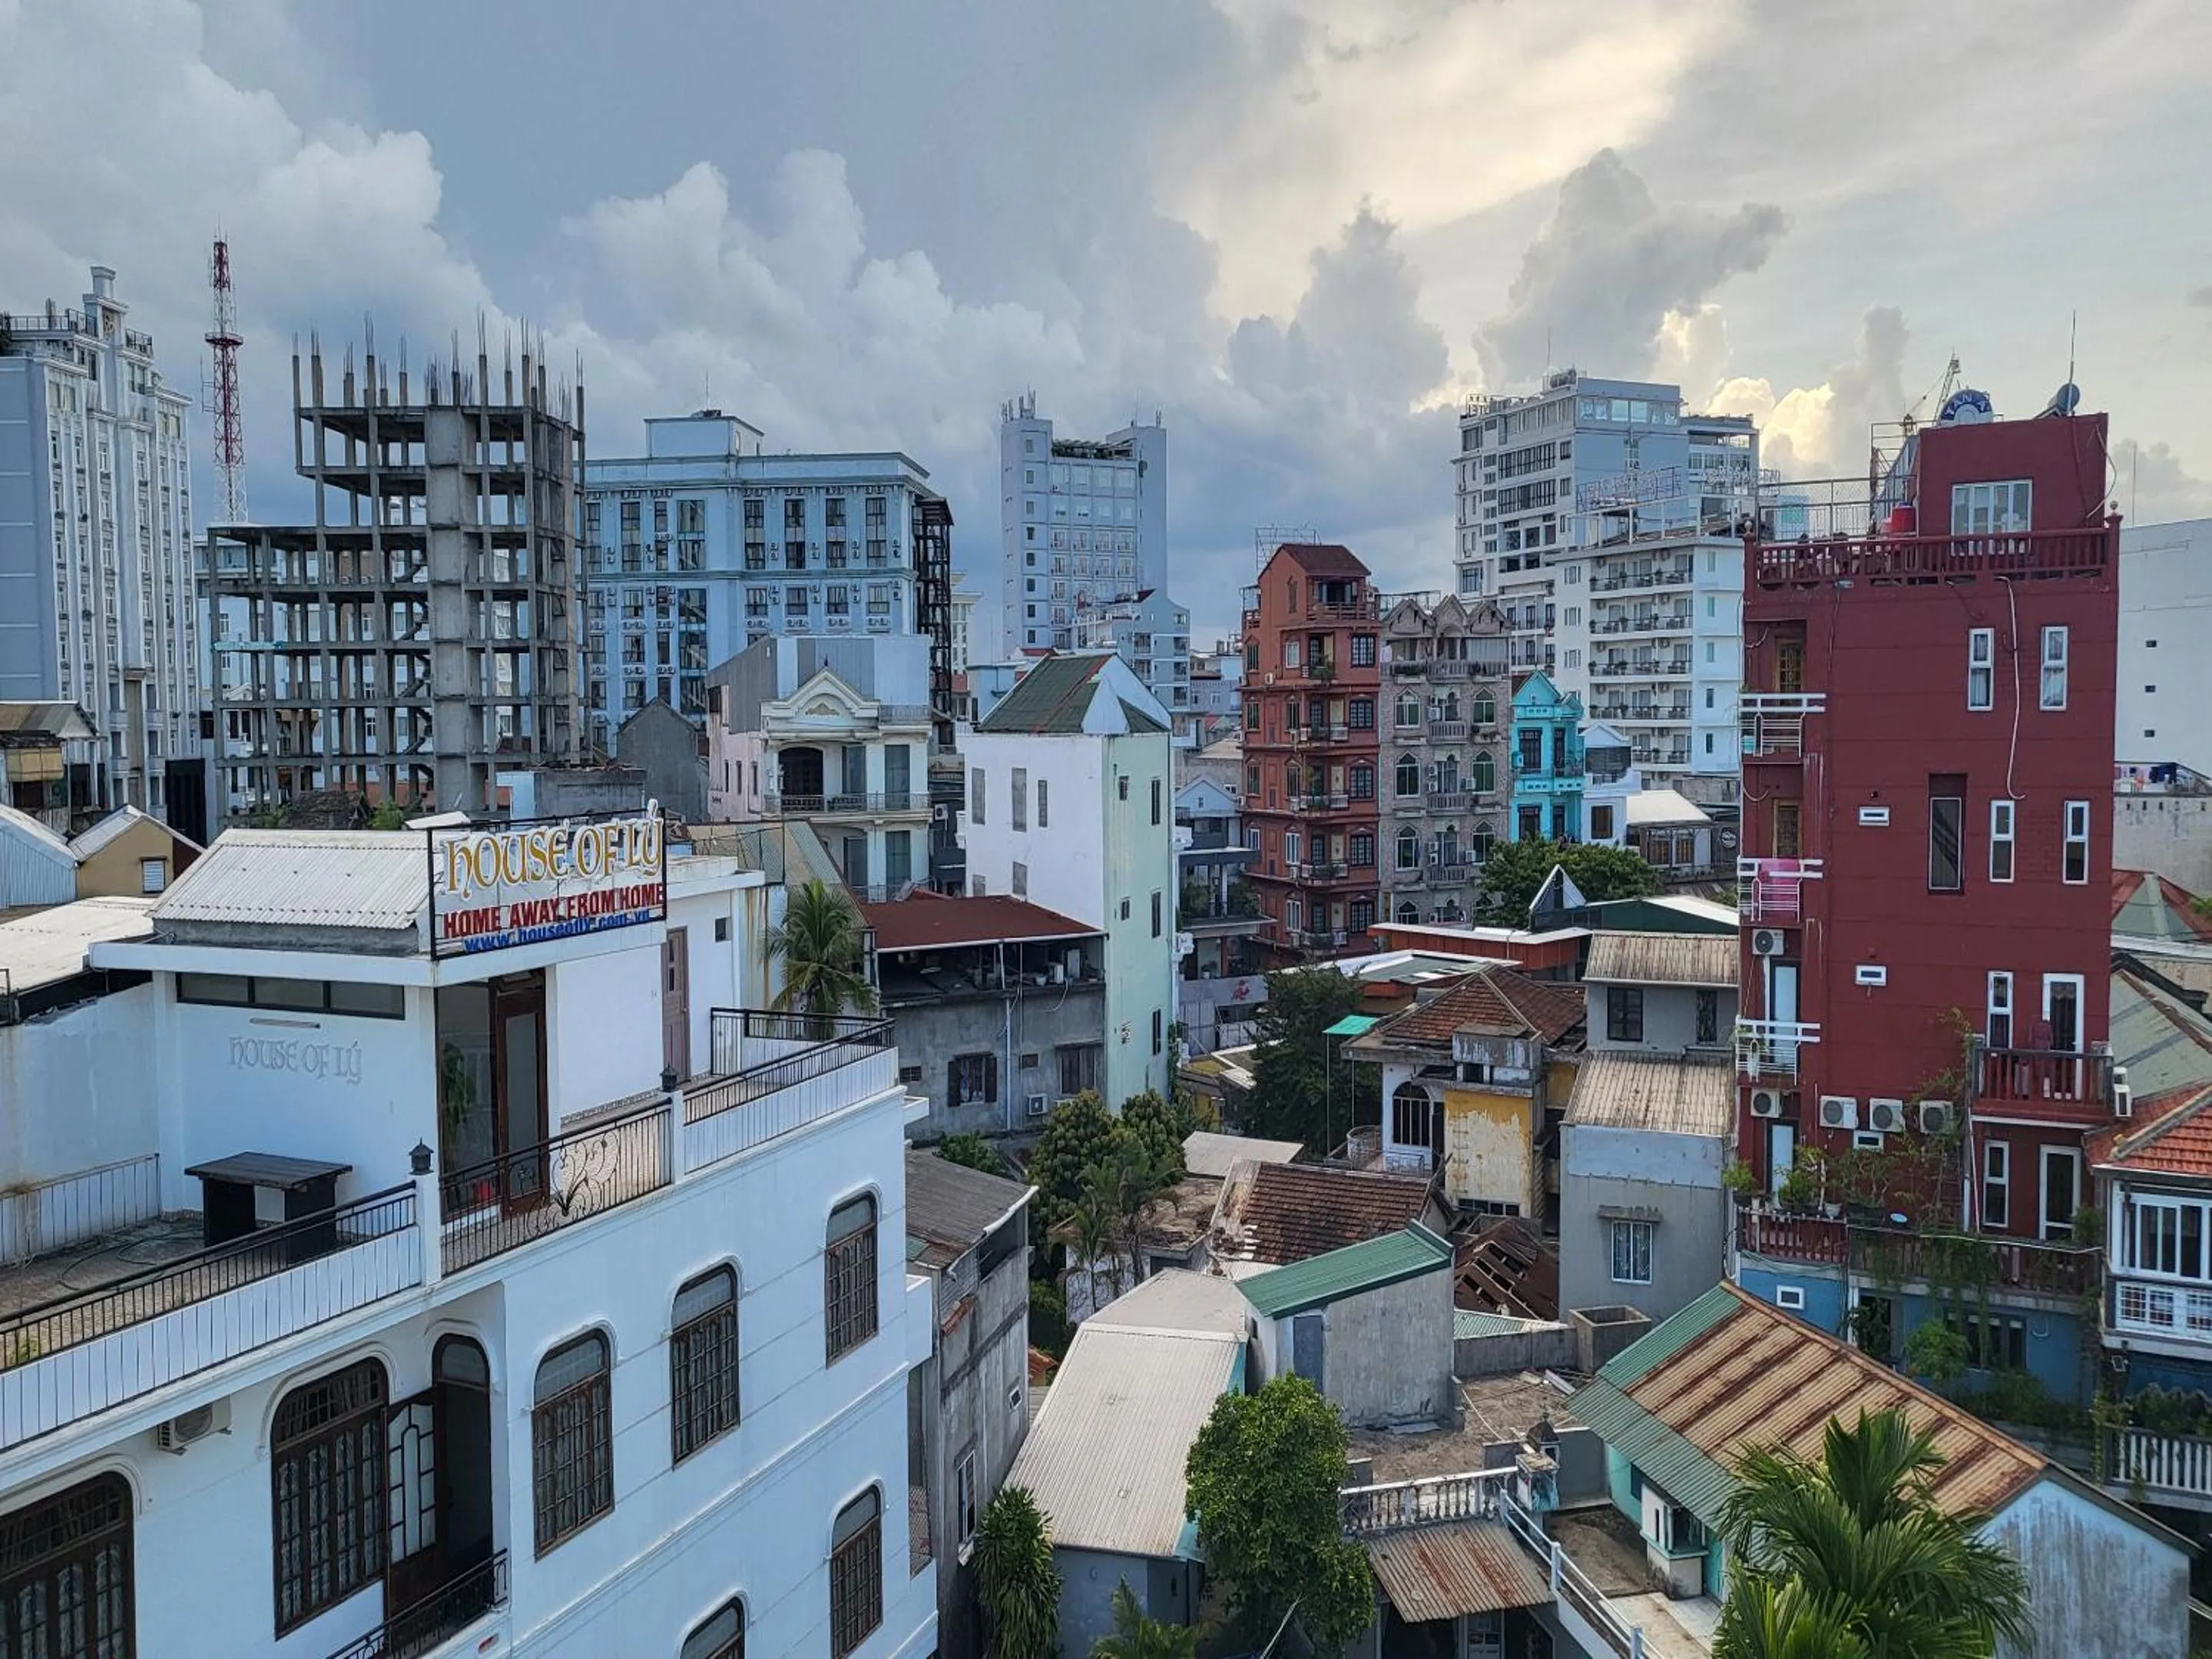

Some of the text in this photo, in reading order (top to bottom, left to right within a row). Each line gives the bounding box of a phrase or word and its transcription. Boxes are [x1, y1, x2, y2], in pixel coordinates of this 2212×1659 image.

[574, 819, 621, 879] OF
[443, 882, 665, 939] HOME AWAY FROM HOME
[304, 1043, 330, 1080] OF
